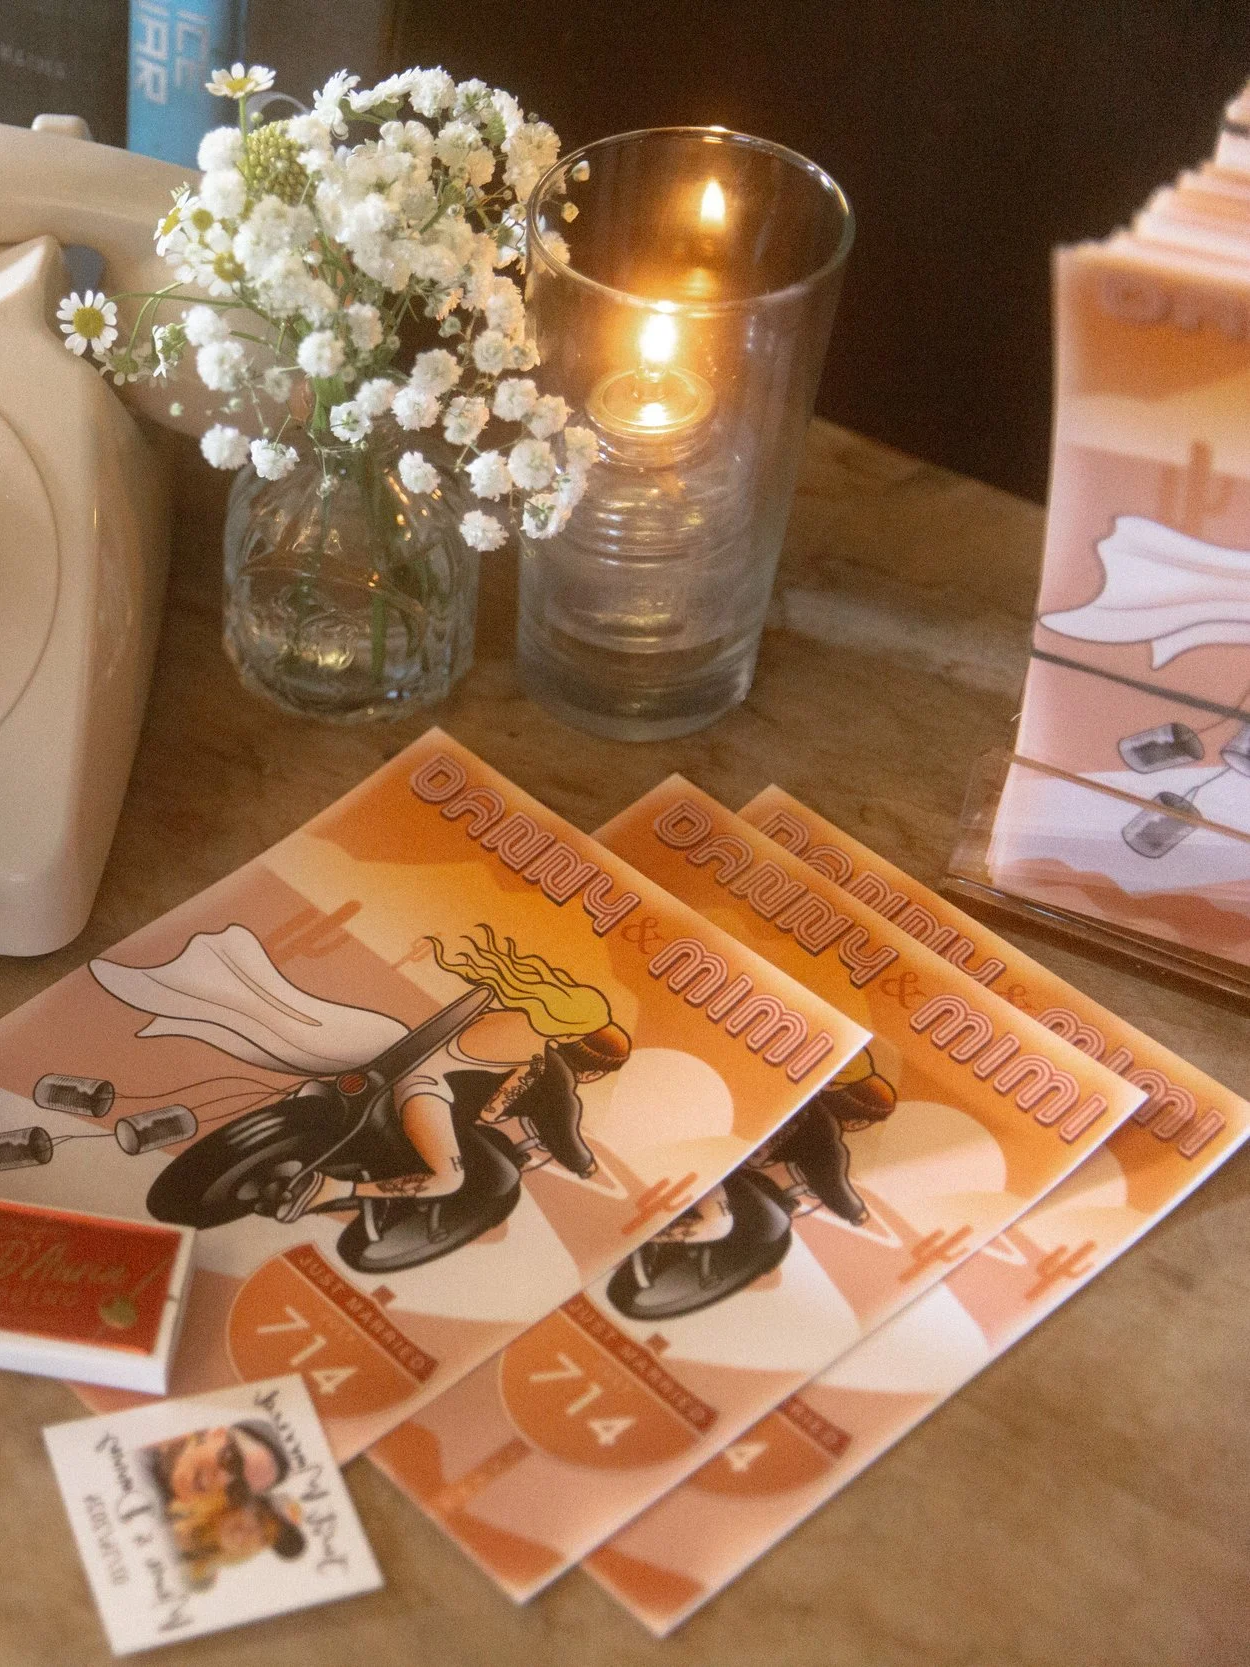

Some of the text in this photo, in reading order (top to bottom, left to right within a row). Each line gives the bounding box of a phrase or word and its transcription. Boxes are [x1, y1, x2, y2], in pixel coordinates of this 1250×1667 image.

[133, 0, 169, 104] AR
[409, 755, 835, 1083] DANNY & MIMI
[653, 799, 1109, 1143] DANNY & MIMI
[255, 1304, 359, 1395] 714
[299, 1254, 427, 1371] JUST MARRIED
[528, 1352, 637, 1446] 714
